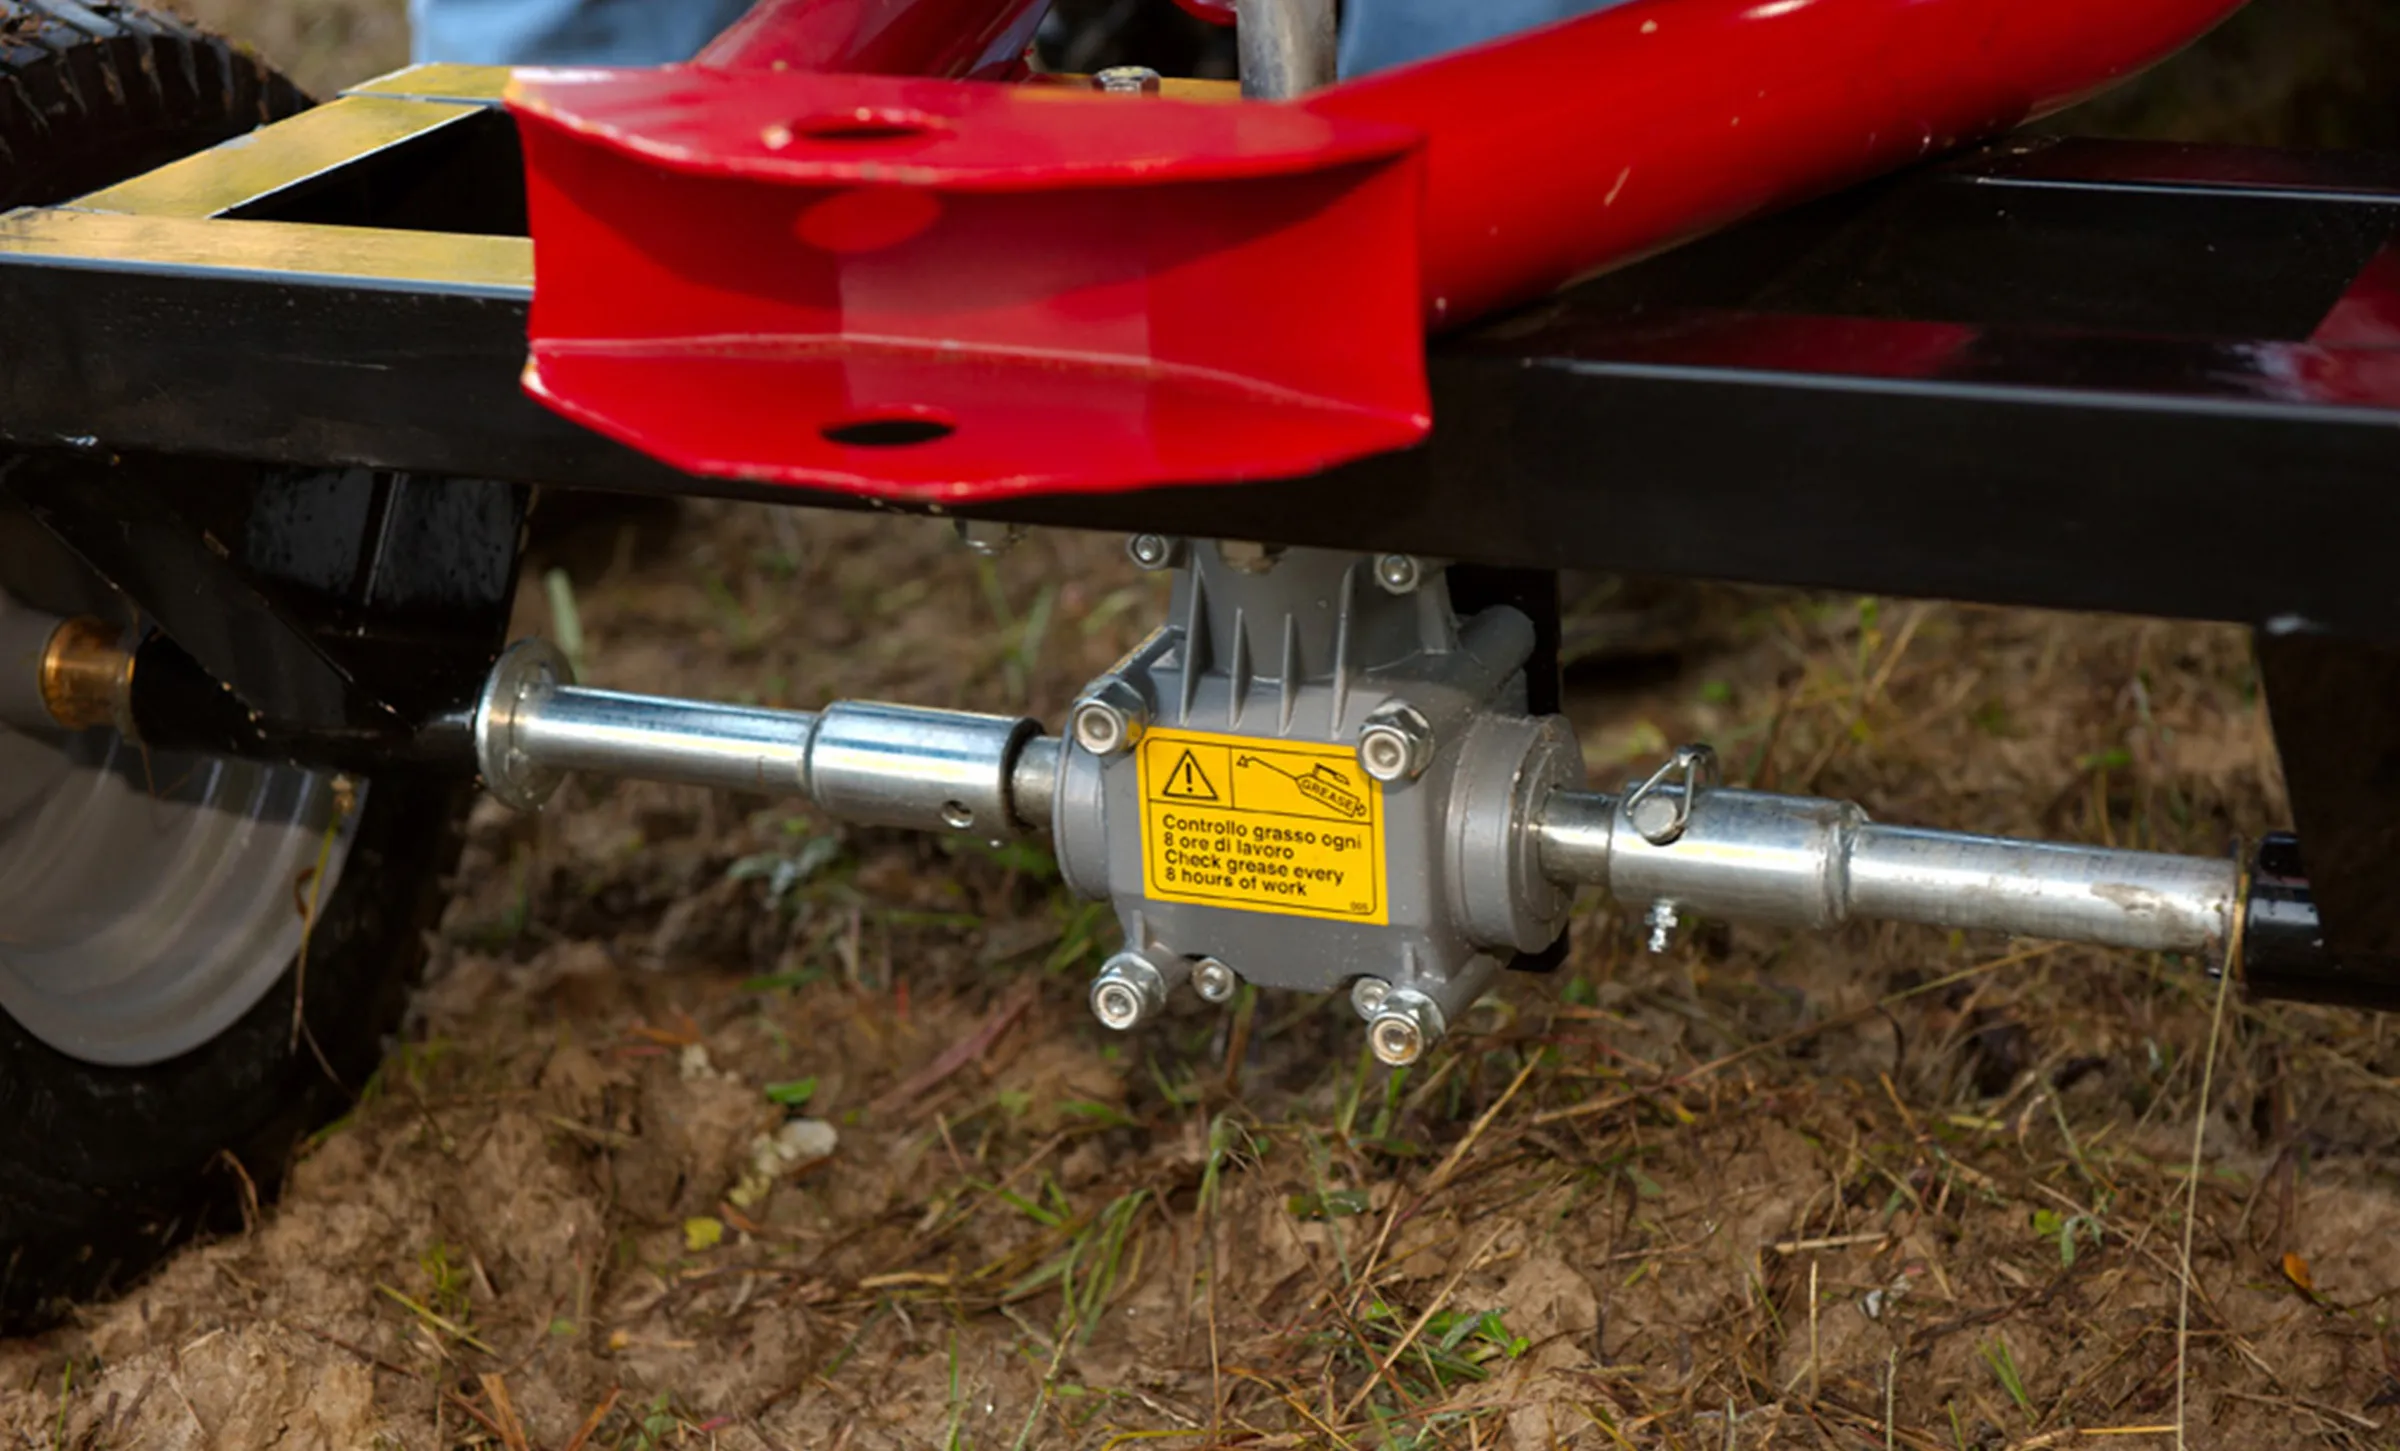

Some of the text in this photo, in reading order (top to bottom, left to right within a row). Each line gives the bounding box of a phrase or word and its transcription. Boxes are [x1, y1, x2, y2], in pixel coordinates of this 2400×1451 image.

[1300, 778, 1353, 810] GREASE
[1163, 814, 1361, 851] Controllo grasso ogni
[1164, 833, 1294, 860] 8 ore di lavoro
[1165, 849, 1344, 886] Check grease every
[1165, 868, 1306, 896] 8 hours of work
